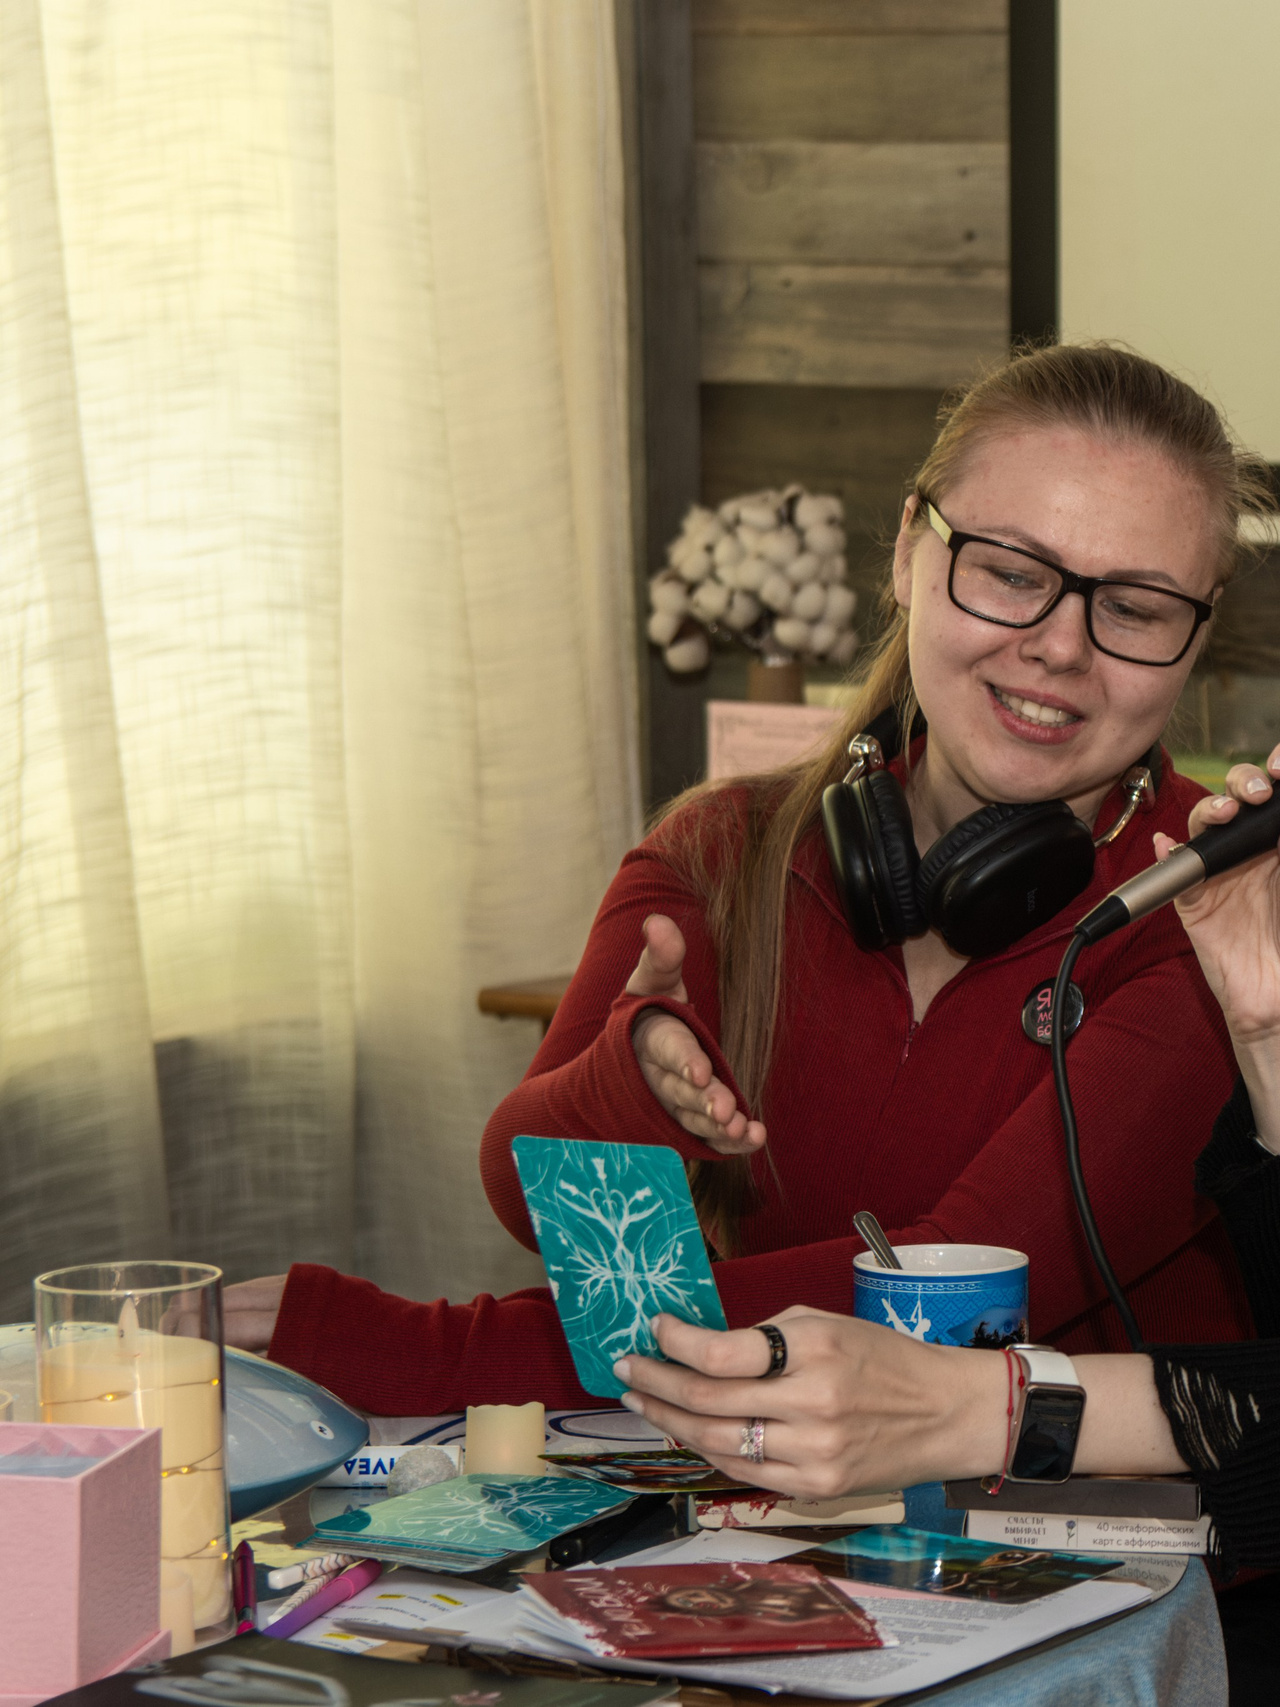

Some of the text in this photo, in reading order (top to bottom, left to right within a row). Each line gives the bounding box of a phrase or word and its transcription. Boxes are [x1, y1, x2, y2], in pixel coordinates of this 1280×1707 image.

[1036, 987, 1052, 1011] Я
[343, 1457, 395, 1476] IVEA
[1004, 1526, 1047, 1536] ВЫБИРАЕТ
[1096, 1521, 1195, 1535] 40 метафорических
[1092, 1537, 1114, 1547] карт
[1124, 1537, 1200, 1549] аффирмациями
